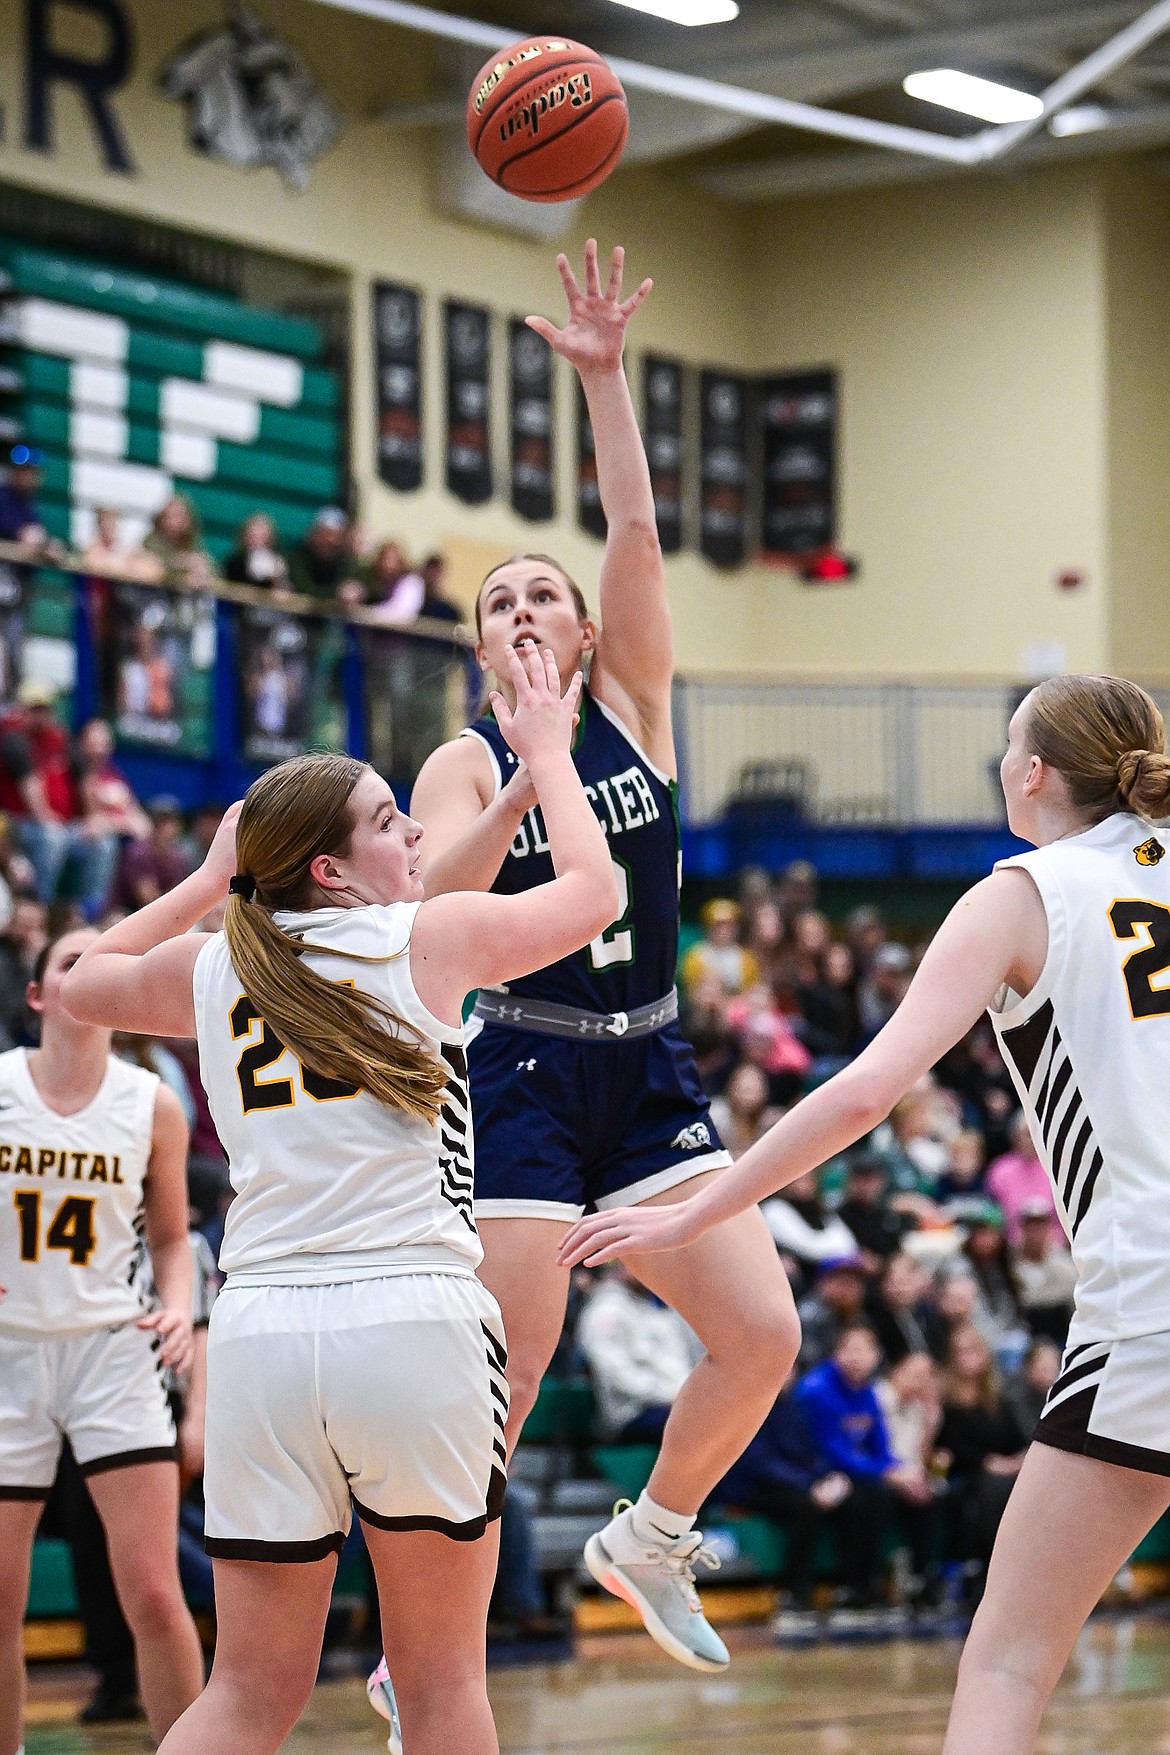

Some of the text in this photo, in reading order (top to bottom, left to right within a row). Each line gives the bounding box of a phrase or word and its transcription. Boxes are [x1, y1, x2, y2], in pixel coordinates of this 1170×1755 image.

[500, 72, 592, 141] Baden
[509, 766, 660, 859] GLCIER
[228, 978, 365, 1116] 2
[0, 1144, 125, 1185] CAPITAL
[13, 1189, 98, 1267] 14
